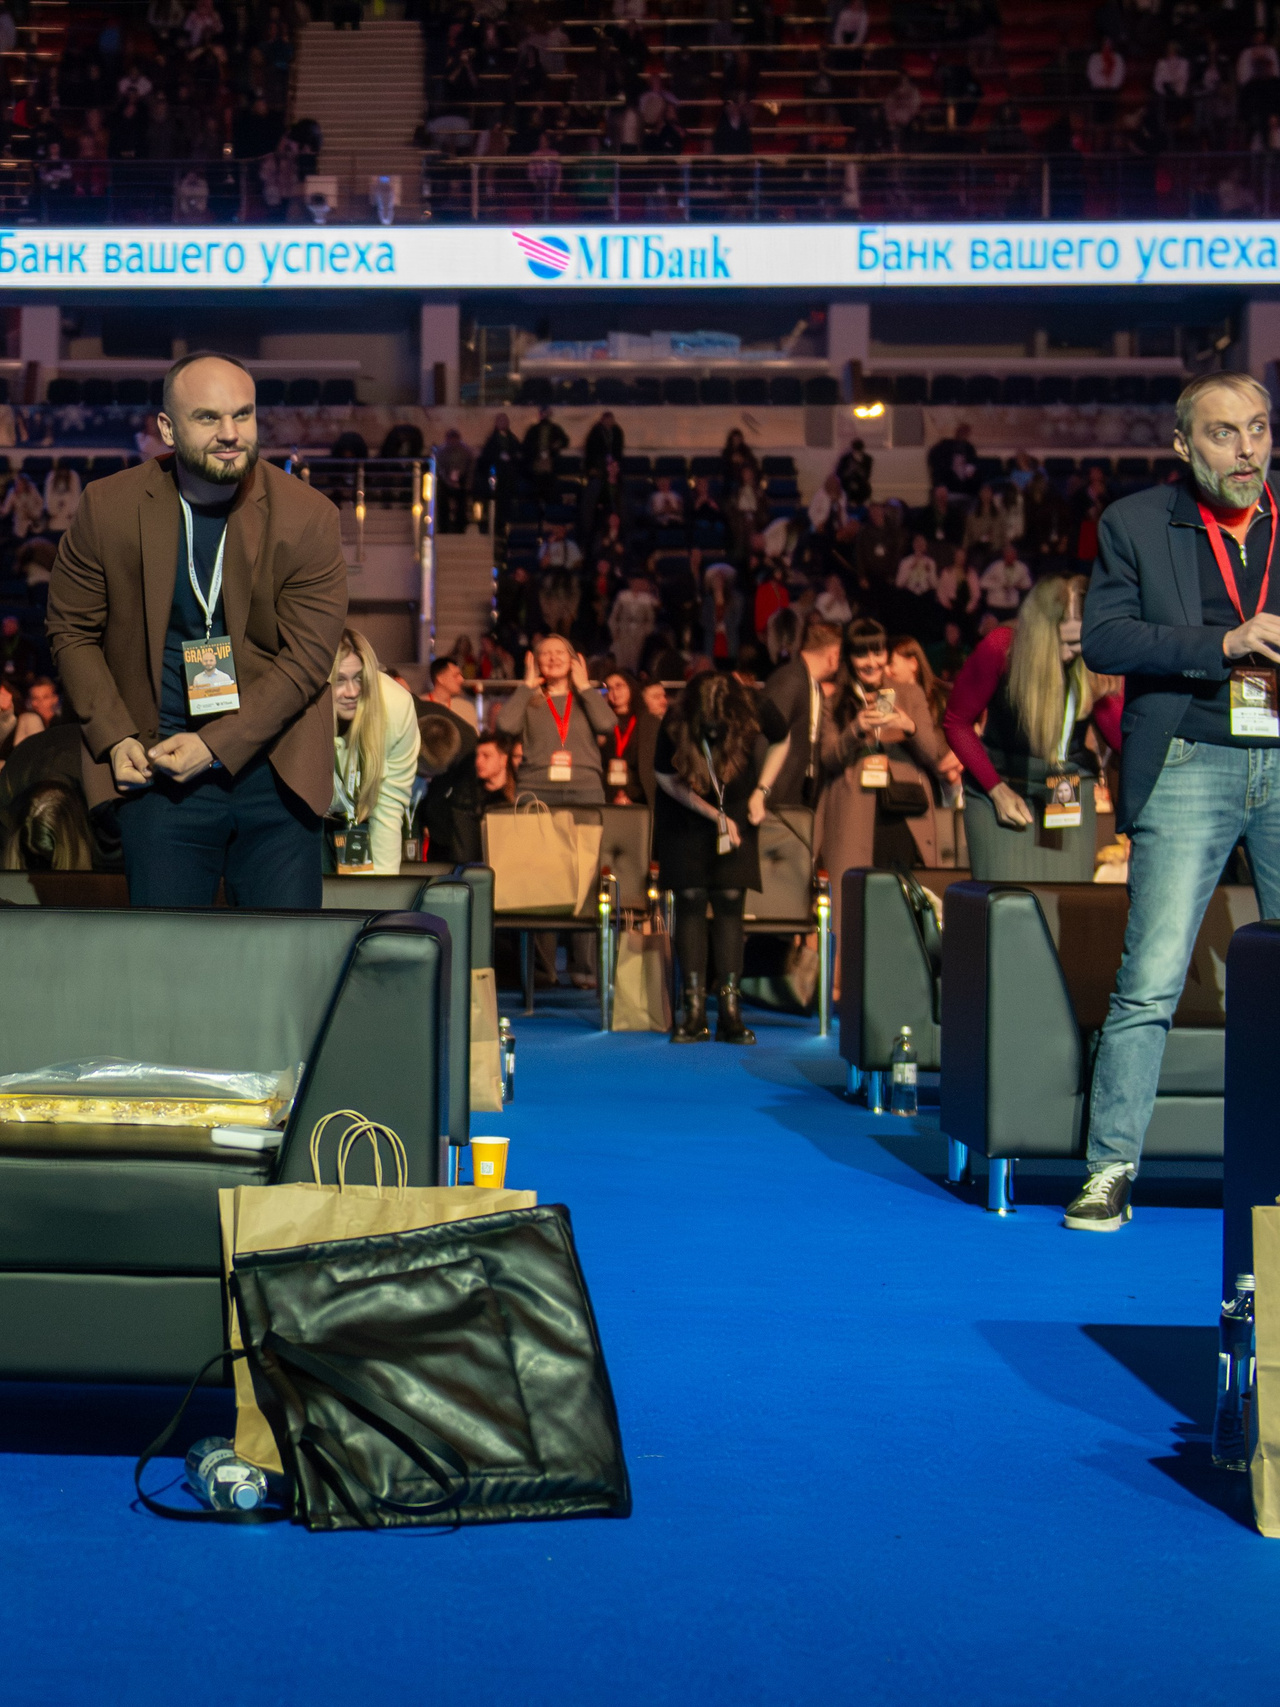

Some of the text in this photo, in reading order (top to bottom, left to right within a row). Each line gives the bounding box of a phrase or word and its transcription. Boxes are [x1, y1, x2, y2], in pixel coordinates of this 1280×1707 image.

[103, 241, 246, 274] вашего
[260, 240, 396, 284] успеха
[575, 233, 732, 281] МТБанк
[857, 228, 1277, 283] Банк вашего успеха
